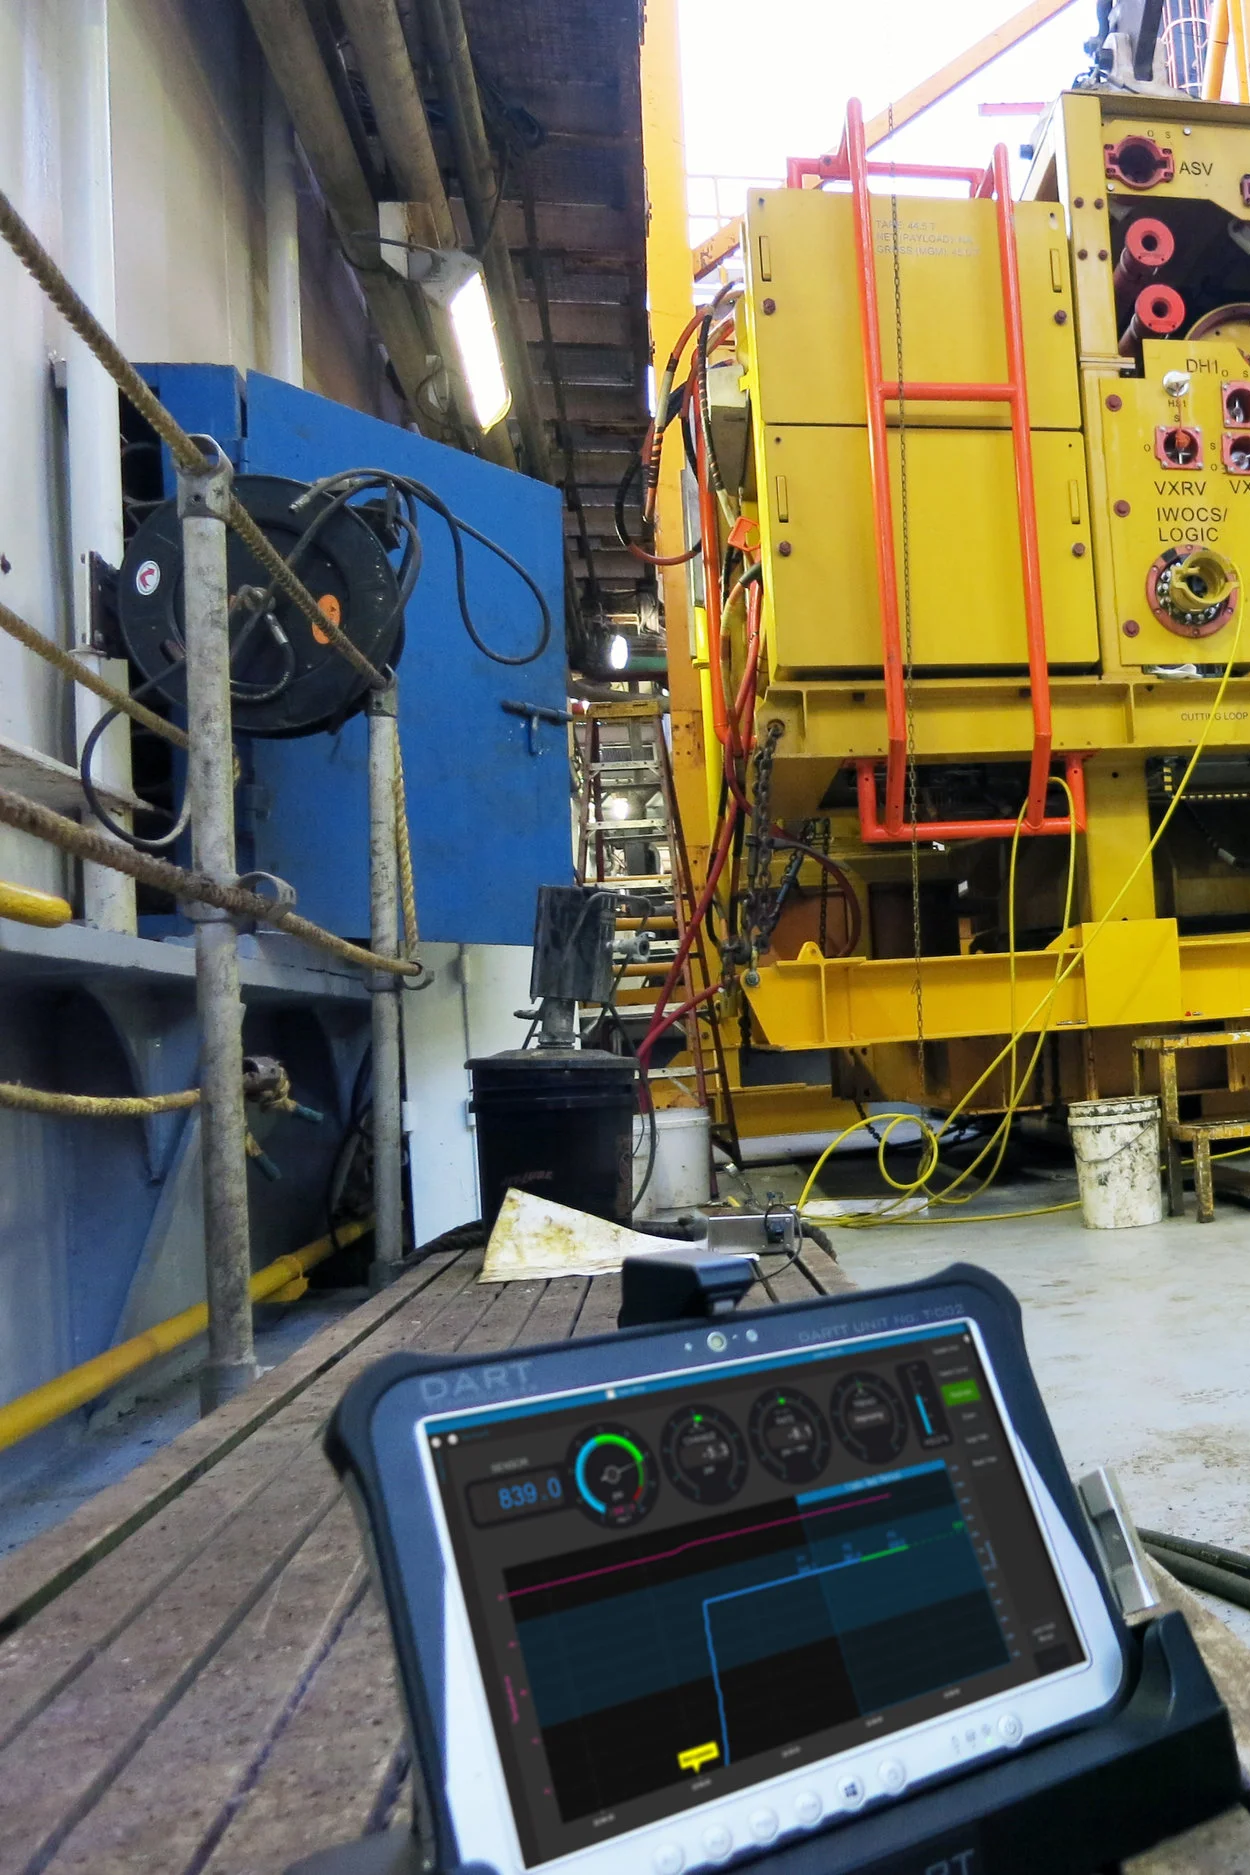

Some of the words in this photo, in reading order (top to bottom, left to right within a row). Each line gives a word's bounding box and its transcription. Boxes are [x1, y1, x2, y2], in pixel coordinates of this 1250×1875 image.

[1179, 161, 1214, 177] ASV
[876, 245, 913, 255] GRSS
[1186, 358, 1218, 374] DH1
[1154, 481, 1207, 496] VXRV
[1156, 507, 1228, 522] IWOCS/
[1158, 527, 1219, 542] LOGIC
[1223, 711, 1249, 721] LOOP
[418, 1359, 534, 1401] DART
[497, 1476, 563, 1511] 839.0
